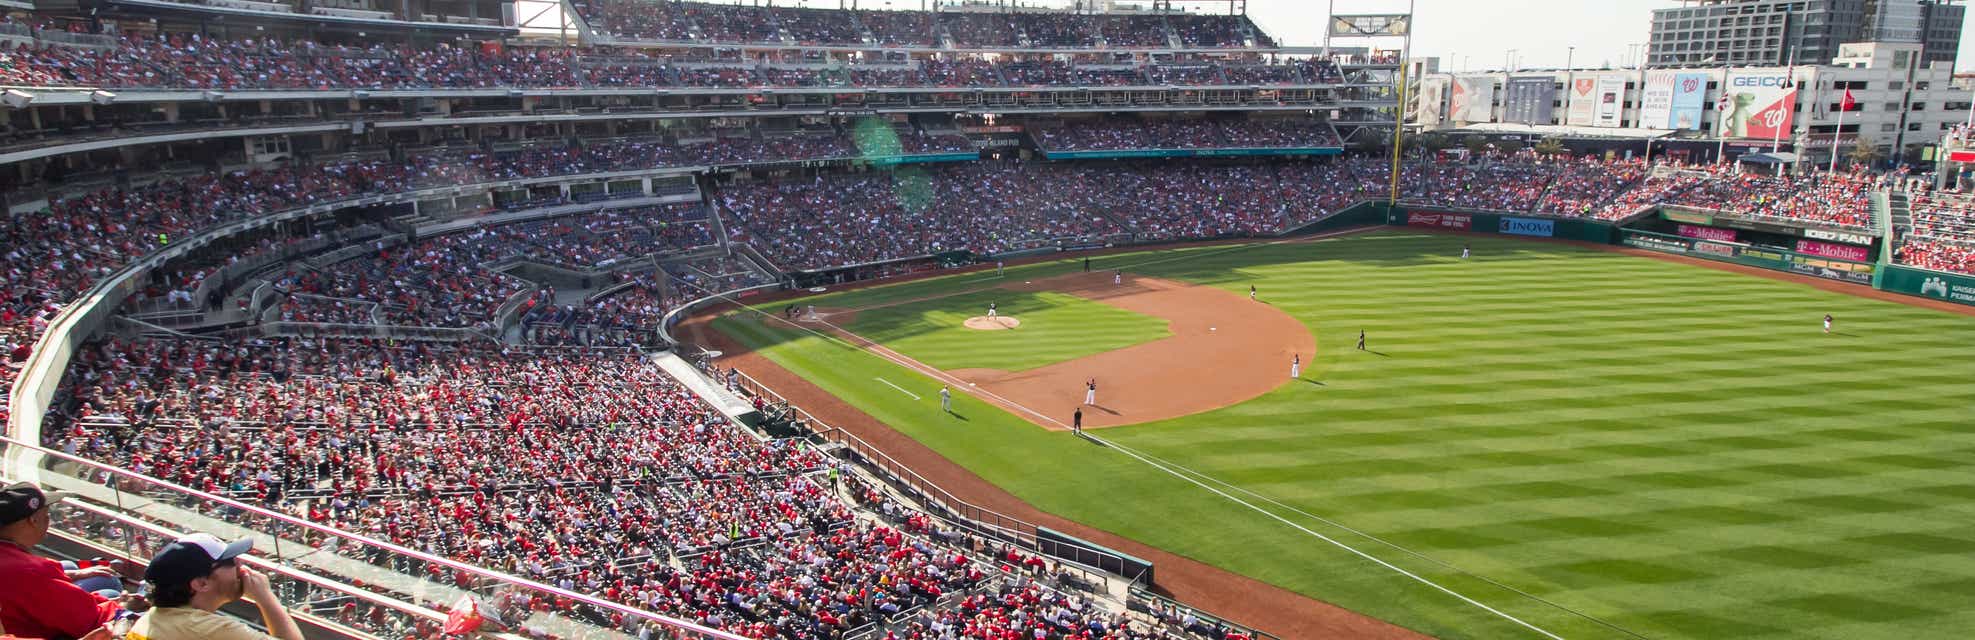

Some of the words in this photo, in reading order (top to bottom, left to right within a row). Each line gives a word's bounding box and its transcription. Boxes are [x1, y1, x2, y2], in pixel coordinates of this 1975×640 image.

[1512, 221, 1551, 233] INOVA
[1839, 234, 1872, 245] FAN
[1794, 263, 1815, 272] MGM
[1846, 271, 1869, 281] MGM
